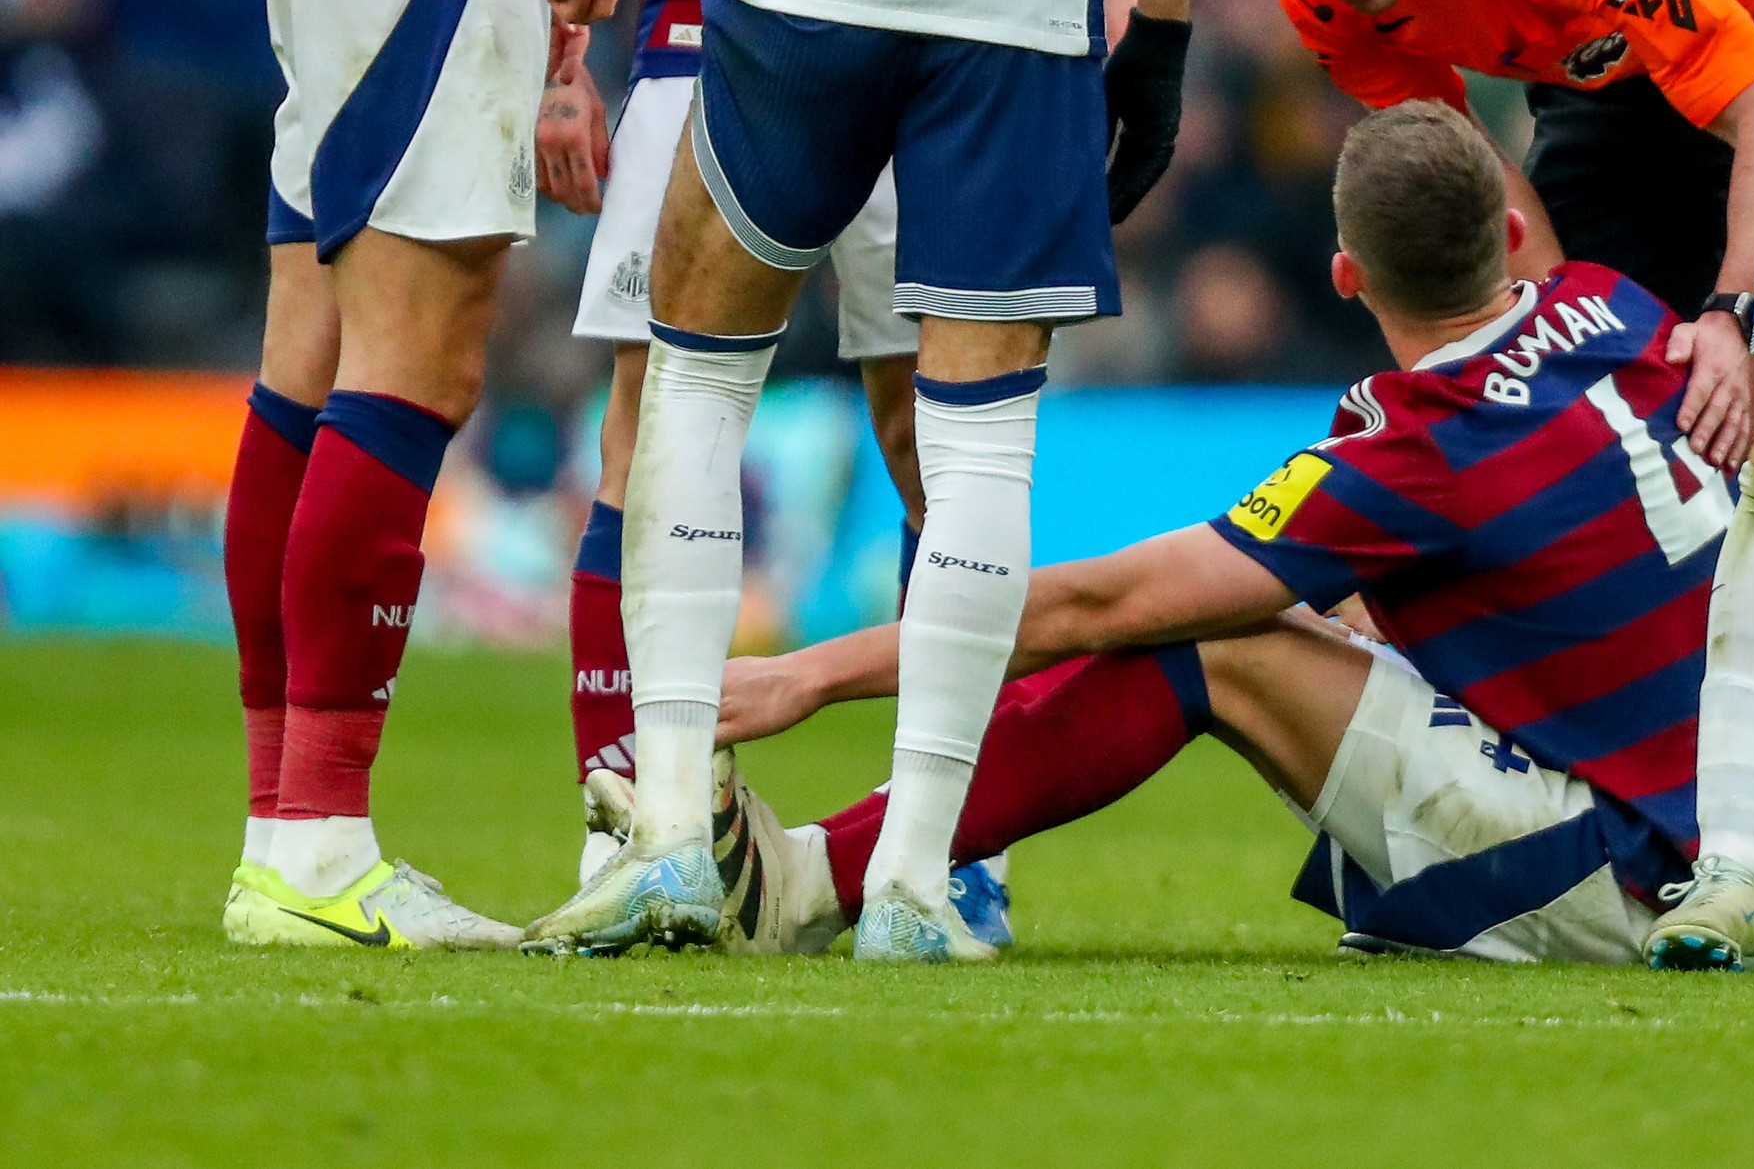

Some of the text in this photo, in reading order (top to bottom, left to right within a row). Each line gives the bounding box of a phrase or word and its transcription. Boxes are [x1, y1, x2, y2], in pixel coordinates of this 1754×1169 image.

[1584, 372, 1737, 567] 4
[669, 523, 741, 541] Spurs
[927, 550, 1010, 577] Spurs
